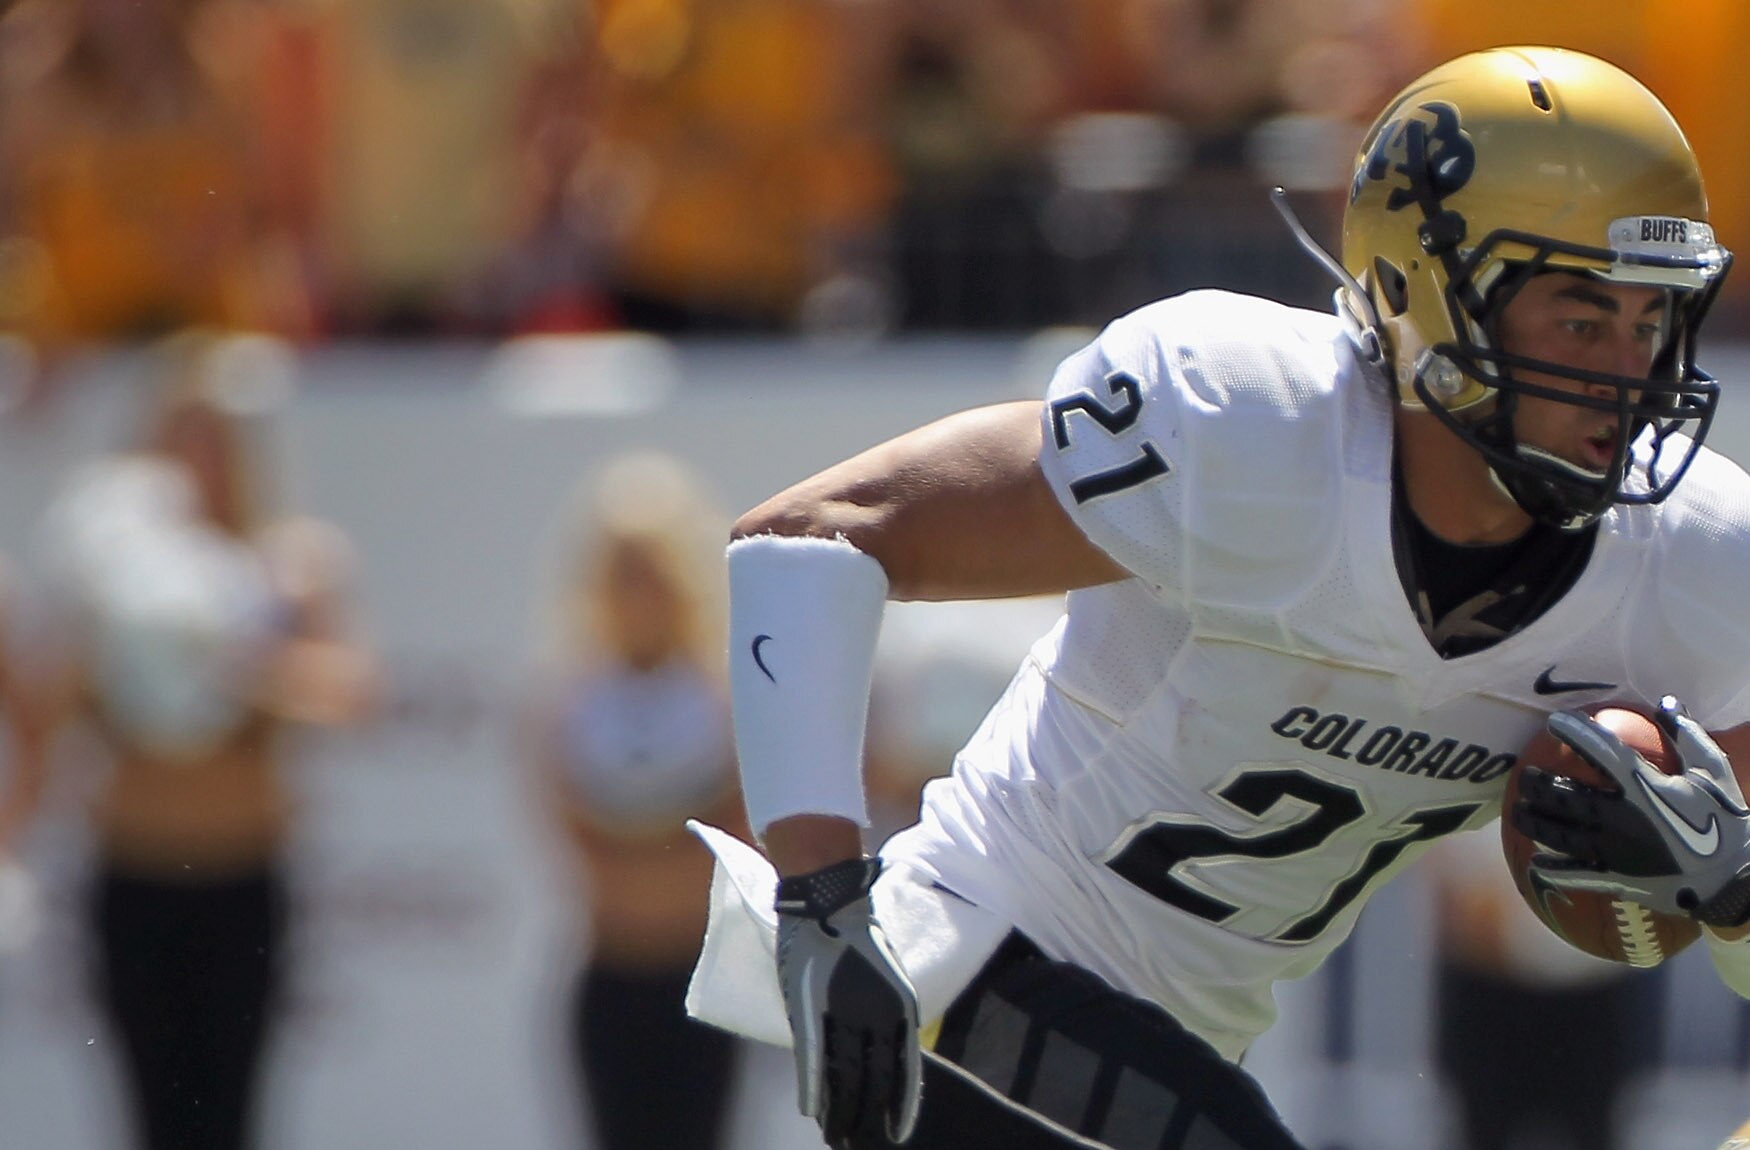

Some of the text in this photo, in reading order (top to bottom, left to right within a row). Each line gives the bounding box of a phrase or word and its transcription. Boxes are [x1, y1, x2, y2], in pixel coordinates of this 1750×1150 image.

[1640, 219, 1688, 243] BUFFS
[1049, 370, 1172, 506] 21
[1270, 705, 1518, 784] COLORADO
[1102, 765, 1486, 943] 21
